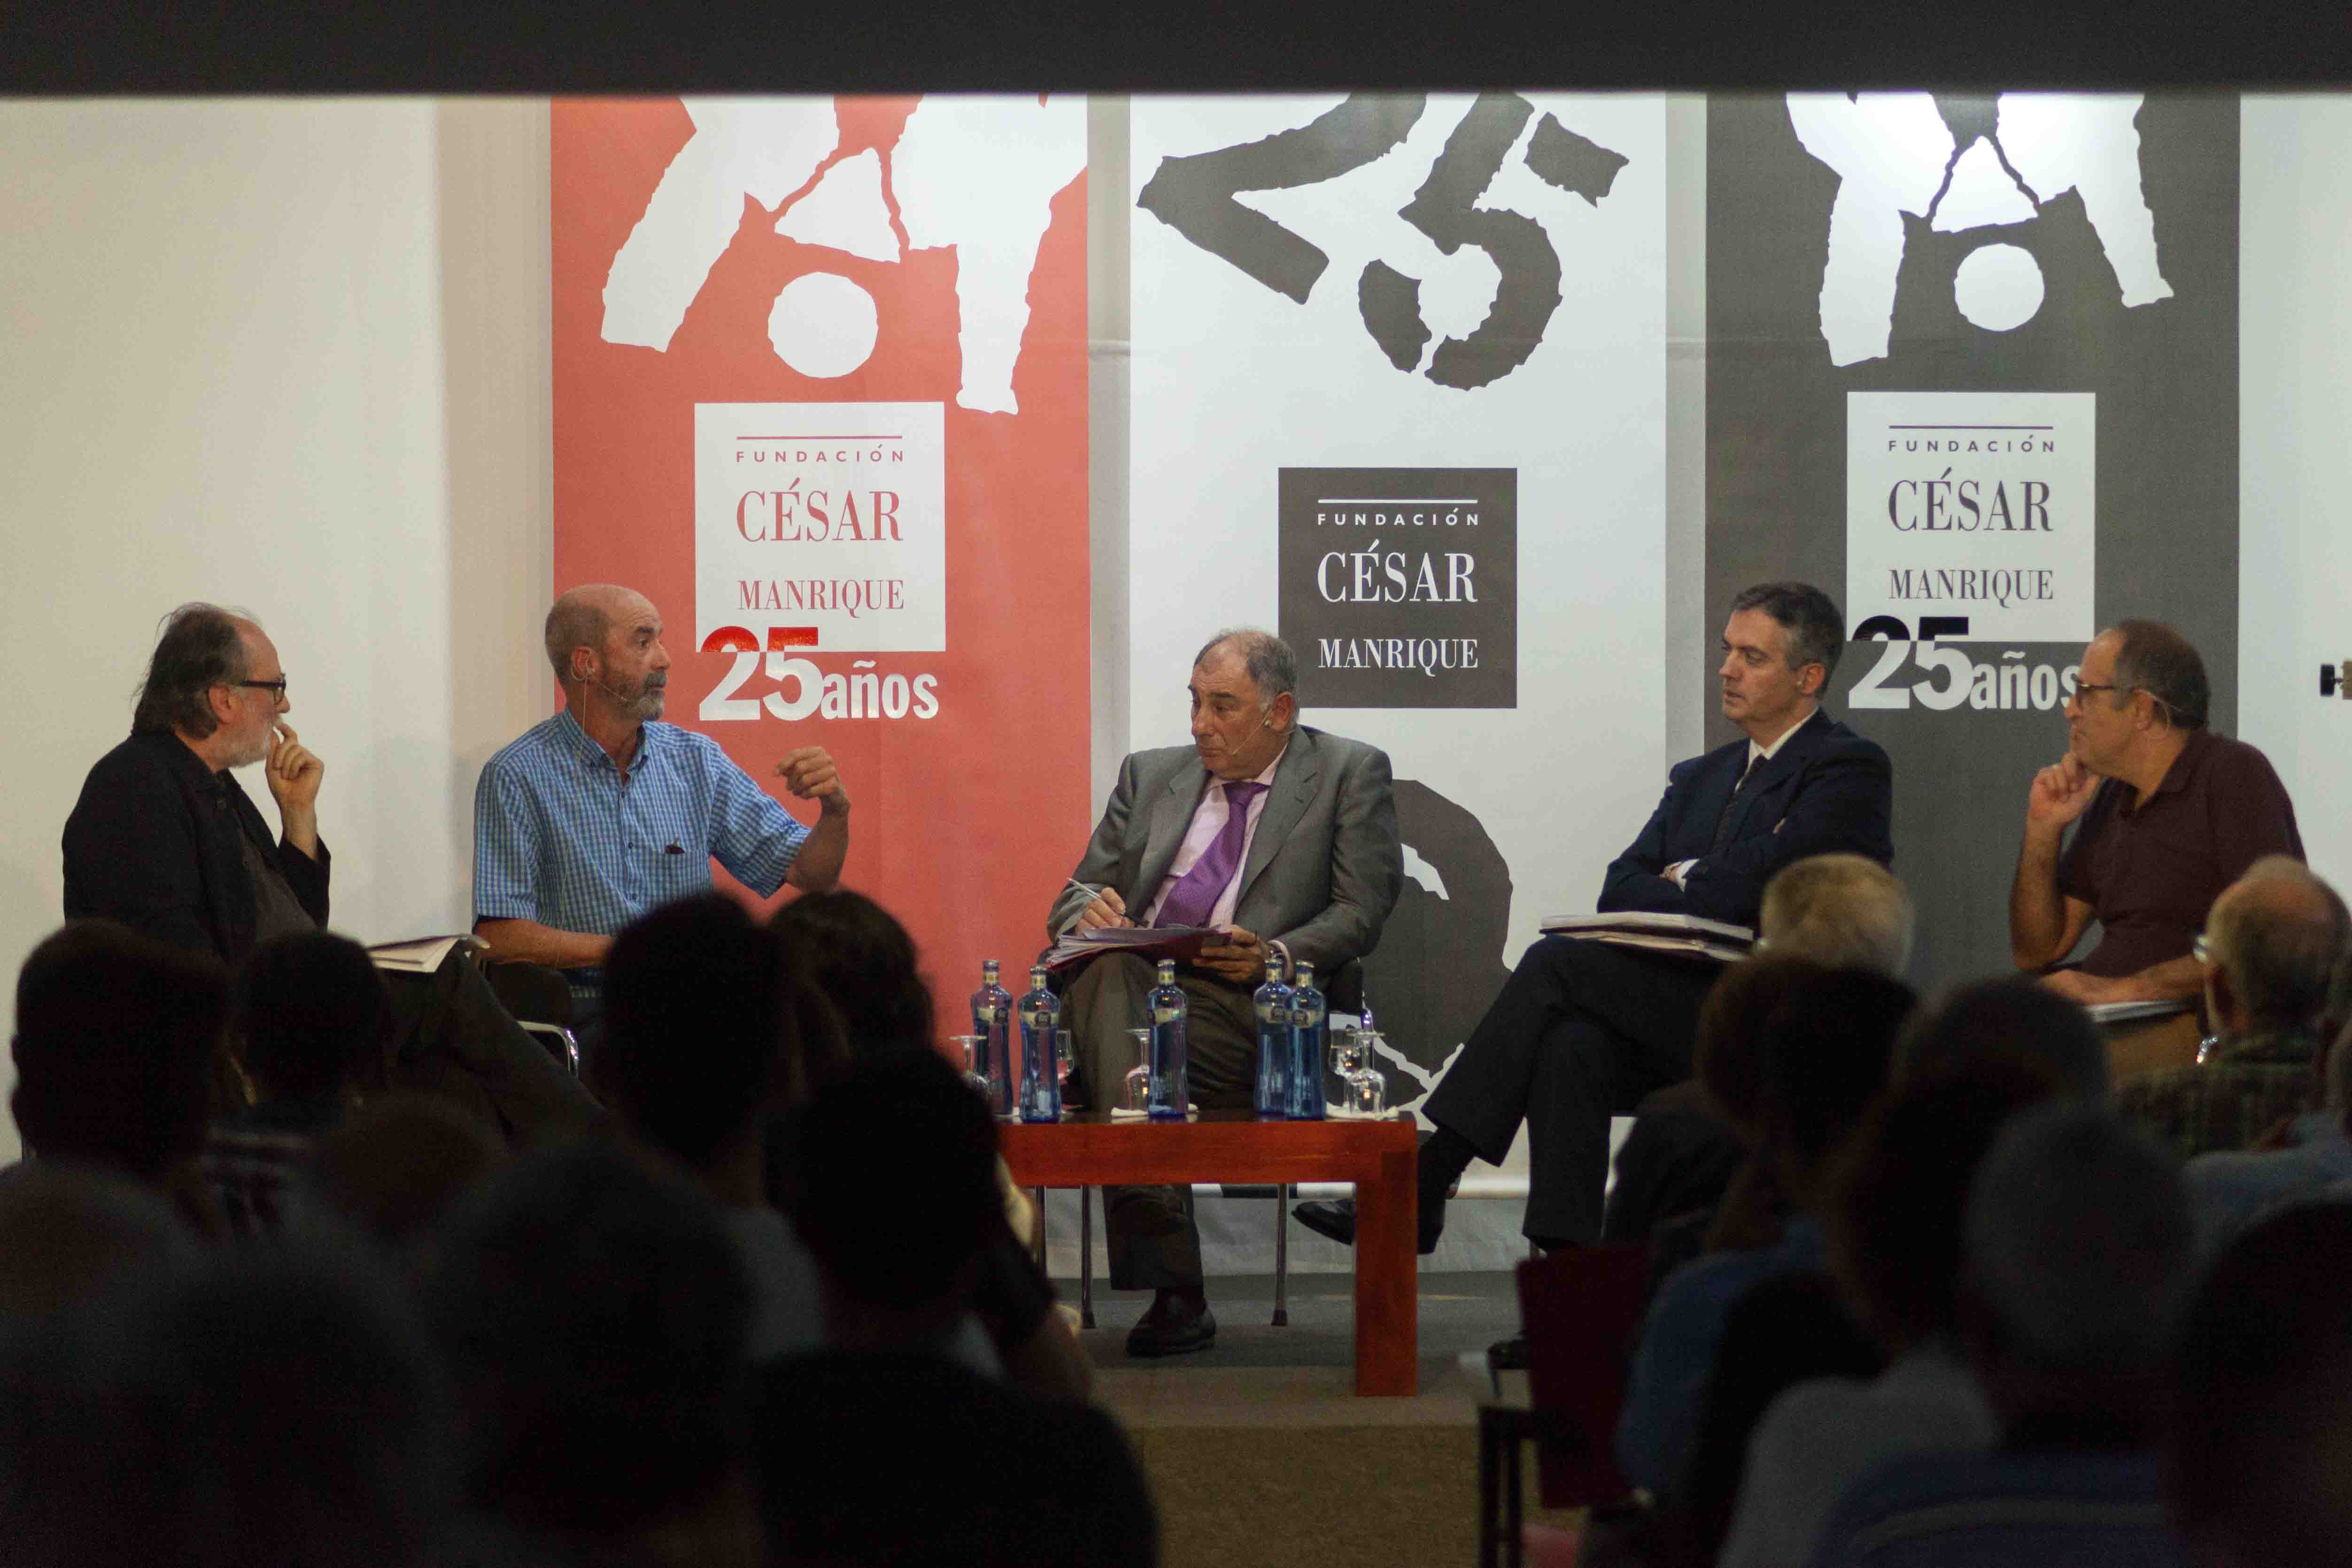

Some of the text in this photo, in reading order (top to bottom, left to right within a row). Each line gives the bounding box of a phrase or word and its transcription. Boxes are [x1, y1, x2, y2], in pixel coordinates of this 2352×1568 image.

[736, 444, 904, 463] FUNDACIÓN
[1889, 435, 2054, 453] FUNDACIÓN
[736, 477, 904, 542] CÉSAR
[1318, 508, 1478, 526] FUNDACIÓN
[1888, 467, 2053, 532] CÉSAR
[1317, 539, 1478, 603] CÉSAR
[1889, 569, 2054, 609] MANRIQUE
[737, 579, 904, 619] MANRIQUE
[1318, 638, 1478, 677] MANRIQUE
